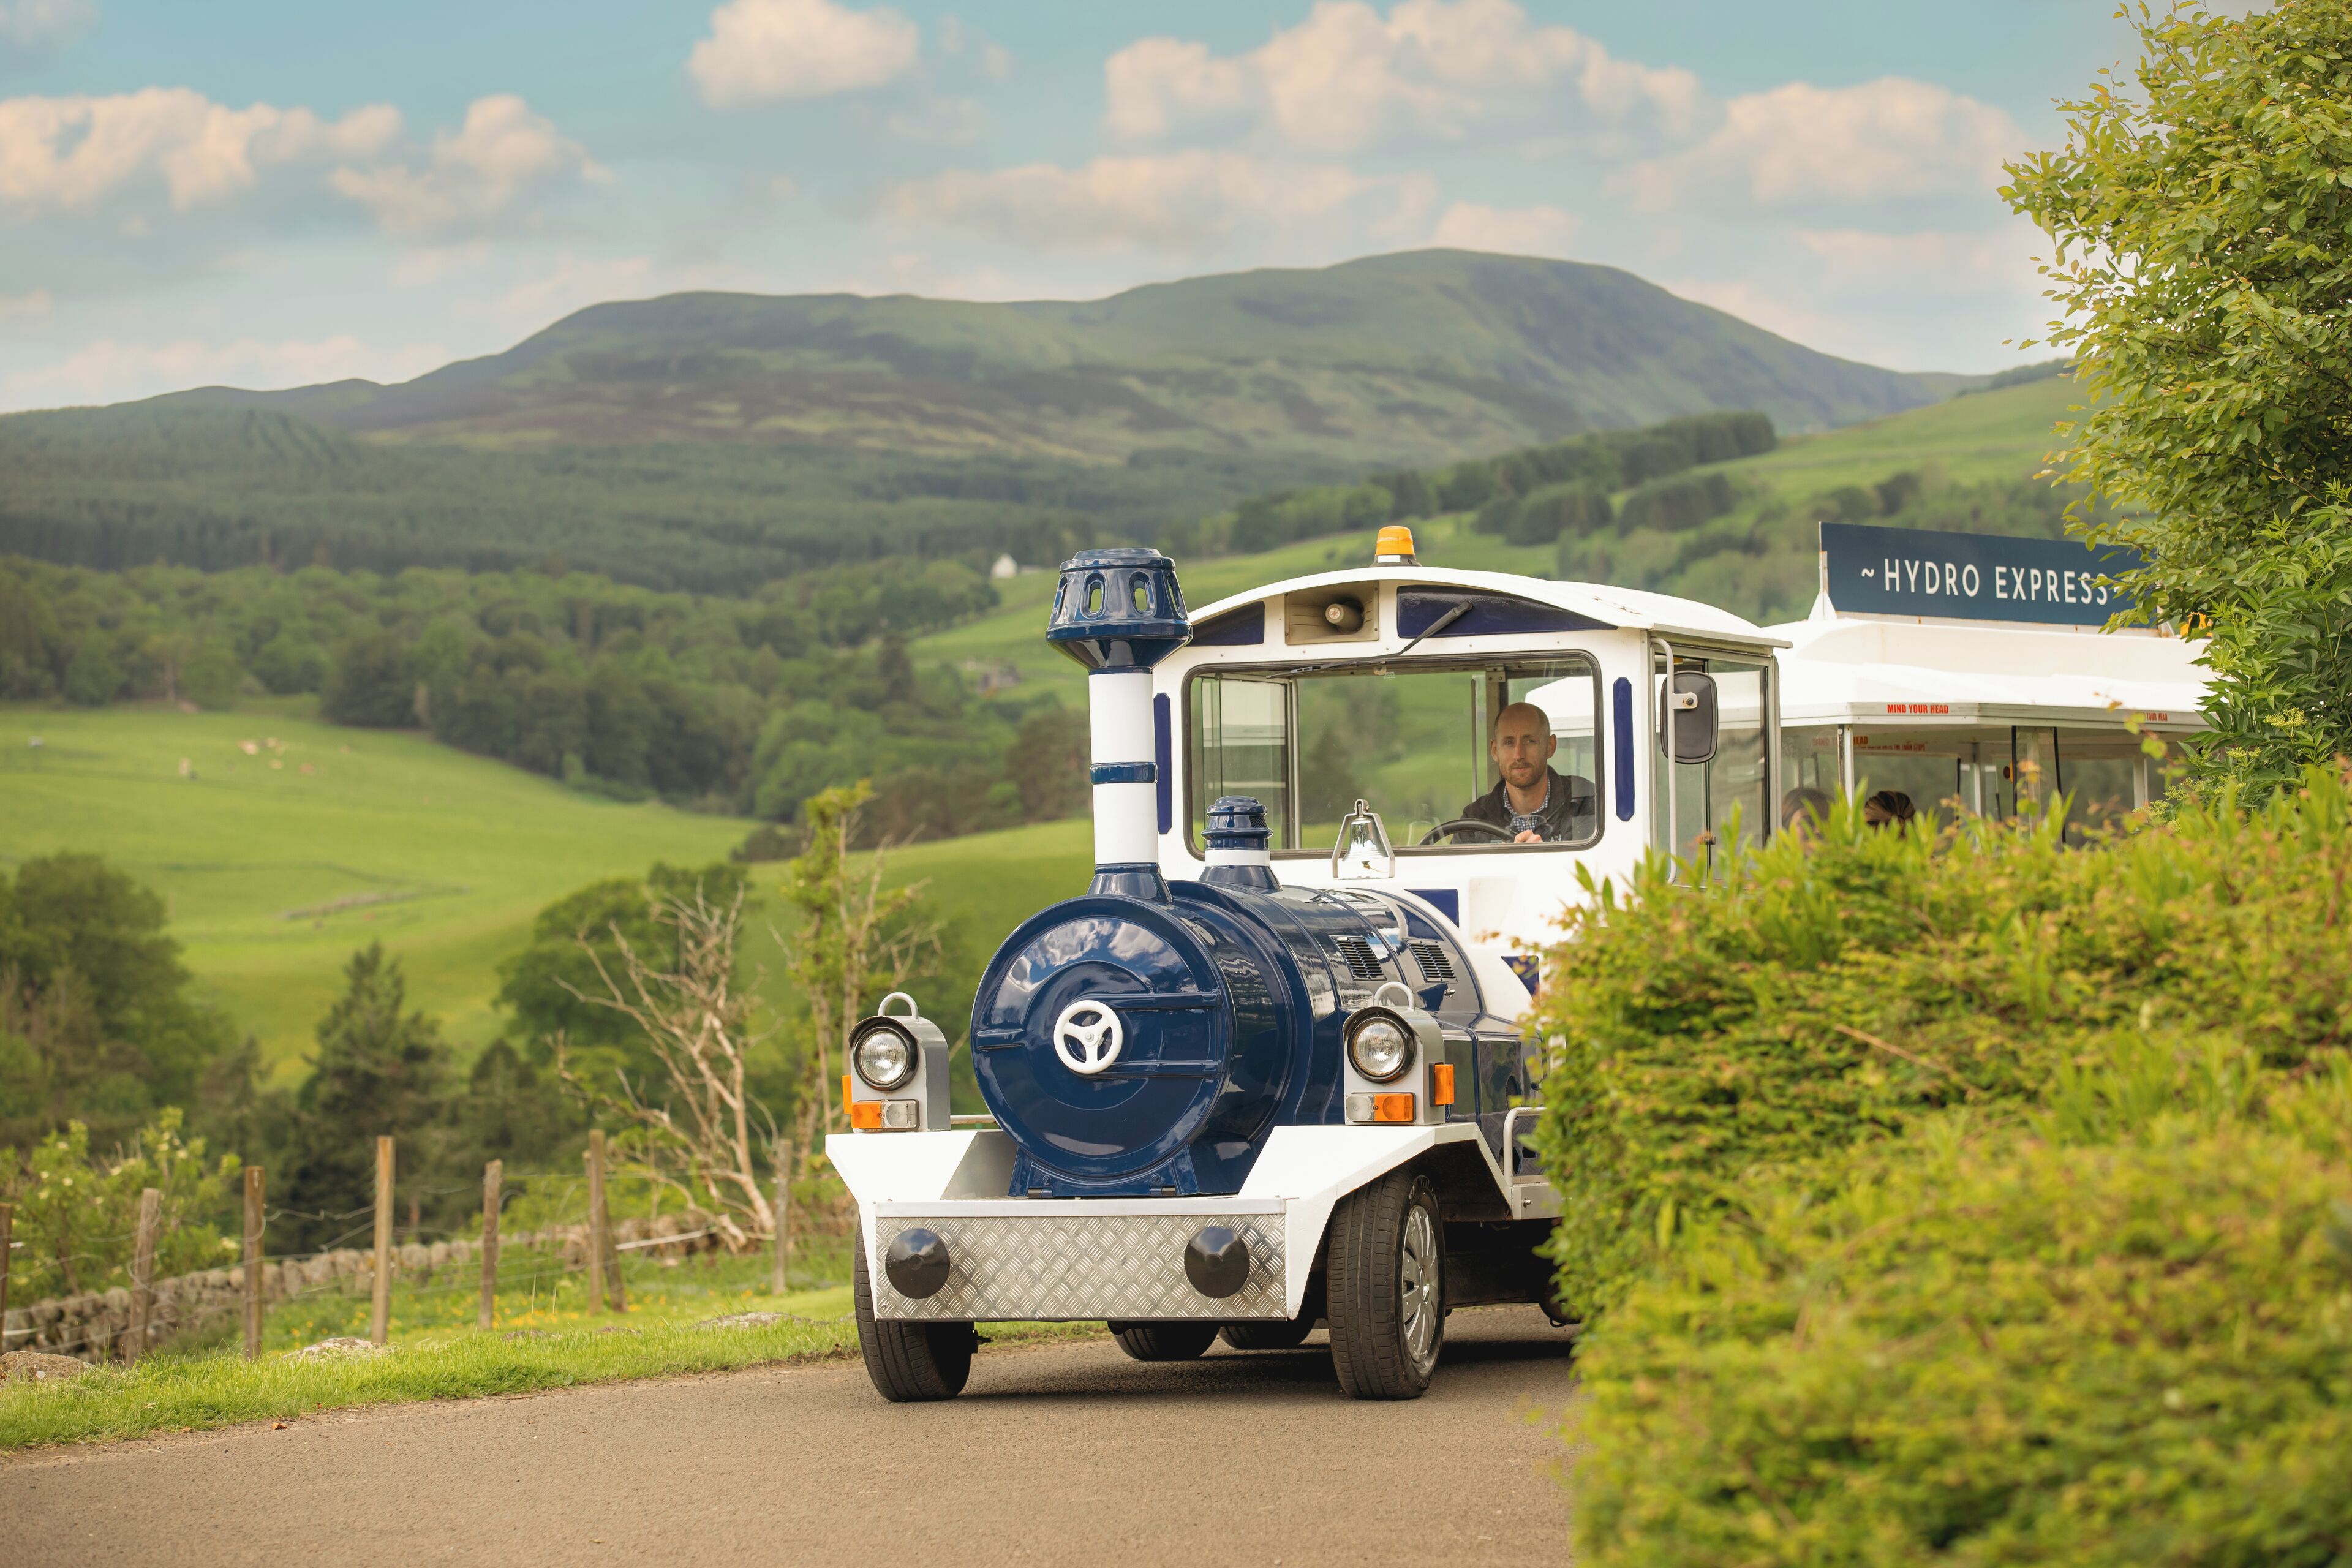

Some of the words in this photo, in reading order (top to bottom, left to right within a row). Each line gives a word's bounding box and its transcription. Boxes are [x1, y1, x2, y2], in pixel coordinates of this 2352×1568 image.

[1885, 558, 1980, 597] HYDRO
[1995, 566, 2108, 605] EXPRESS
[1887, 704, 1906, 714] MIND
[1909, 704, 1928, 714] YOUR
[1930, 704, 1948, 714] HEAD
